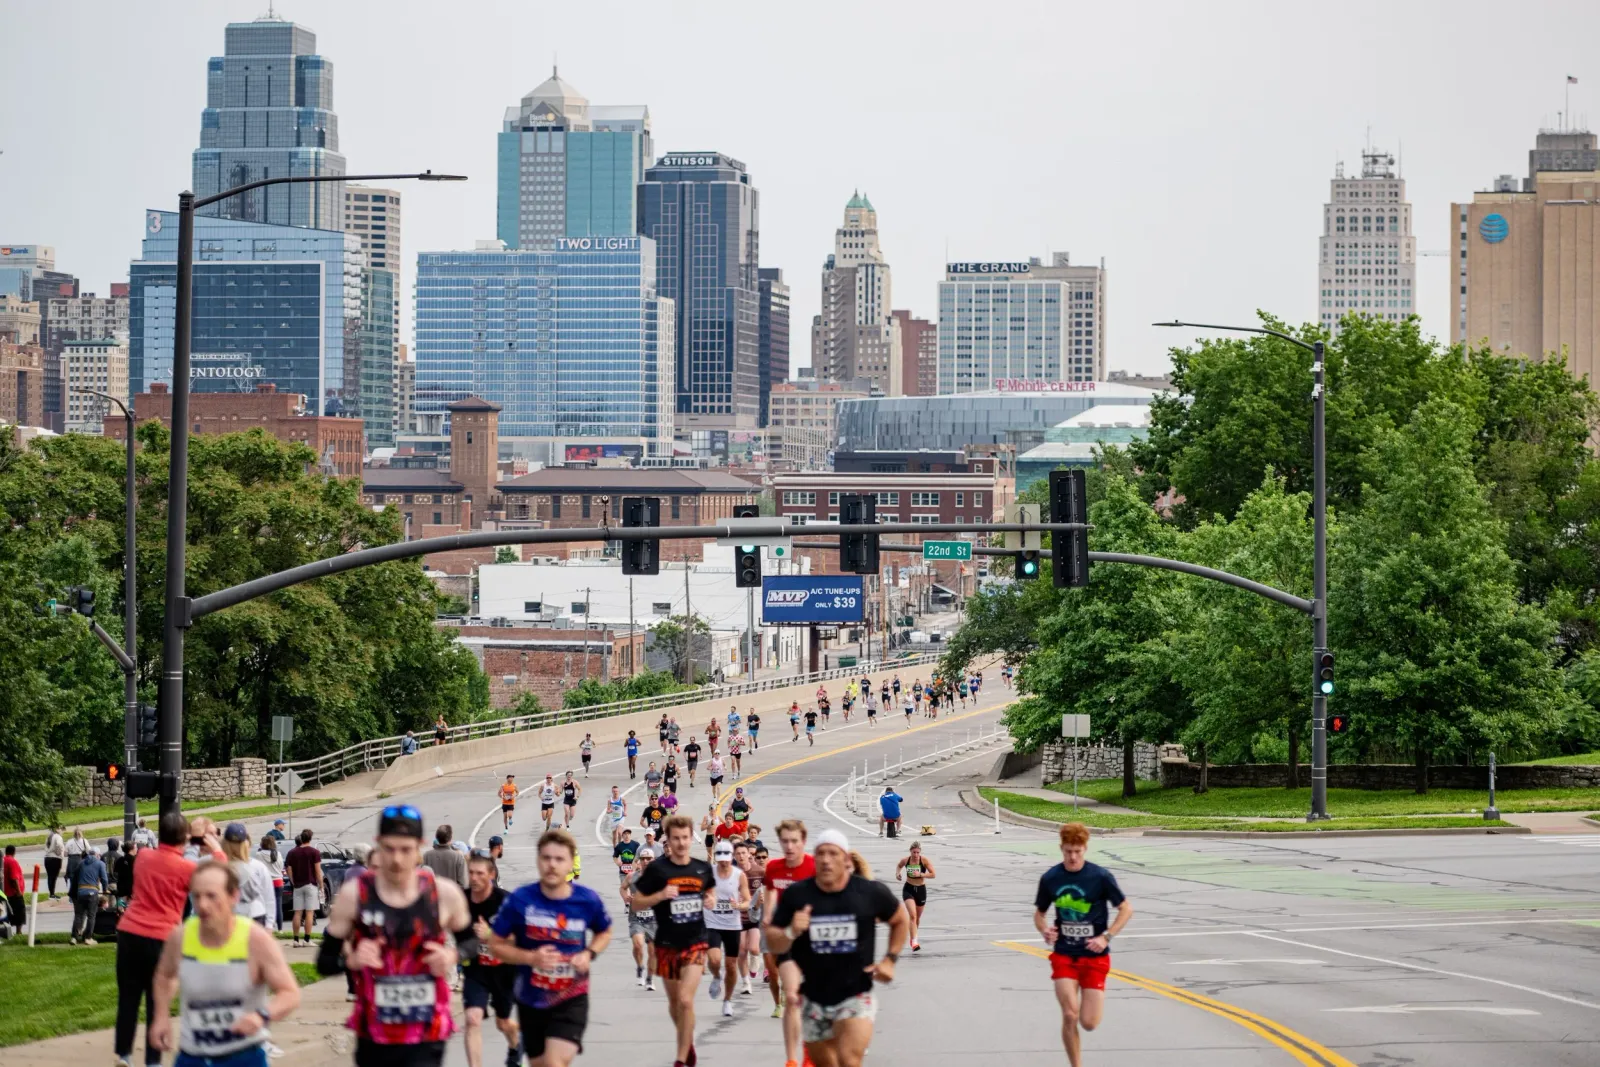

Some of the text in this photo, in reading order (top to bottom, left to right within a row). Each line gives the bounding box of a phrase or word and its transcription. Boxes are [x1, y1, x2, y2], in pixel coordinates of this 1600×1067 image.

[663, 156, 714, 166] STINSON
[148, 212, 163, 234] 3
[558, 238, 638, 250] TWO LIGHT
[948, 263, 1030, 273] THE GRAND
[167, 367, 262, 378] SENTOLOGY
[1050, 382, 1096, 392] CENTER
[928, 545, 967, 556] 22nd St
[768, 591, 807, 603] MVP
[833, 597, 856, 608] $39
[674, 902, 700, 911] 1204
[816, 926, 849, 937] 1277
[1063, 927, 1090, 936] 1020
